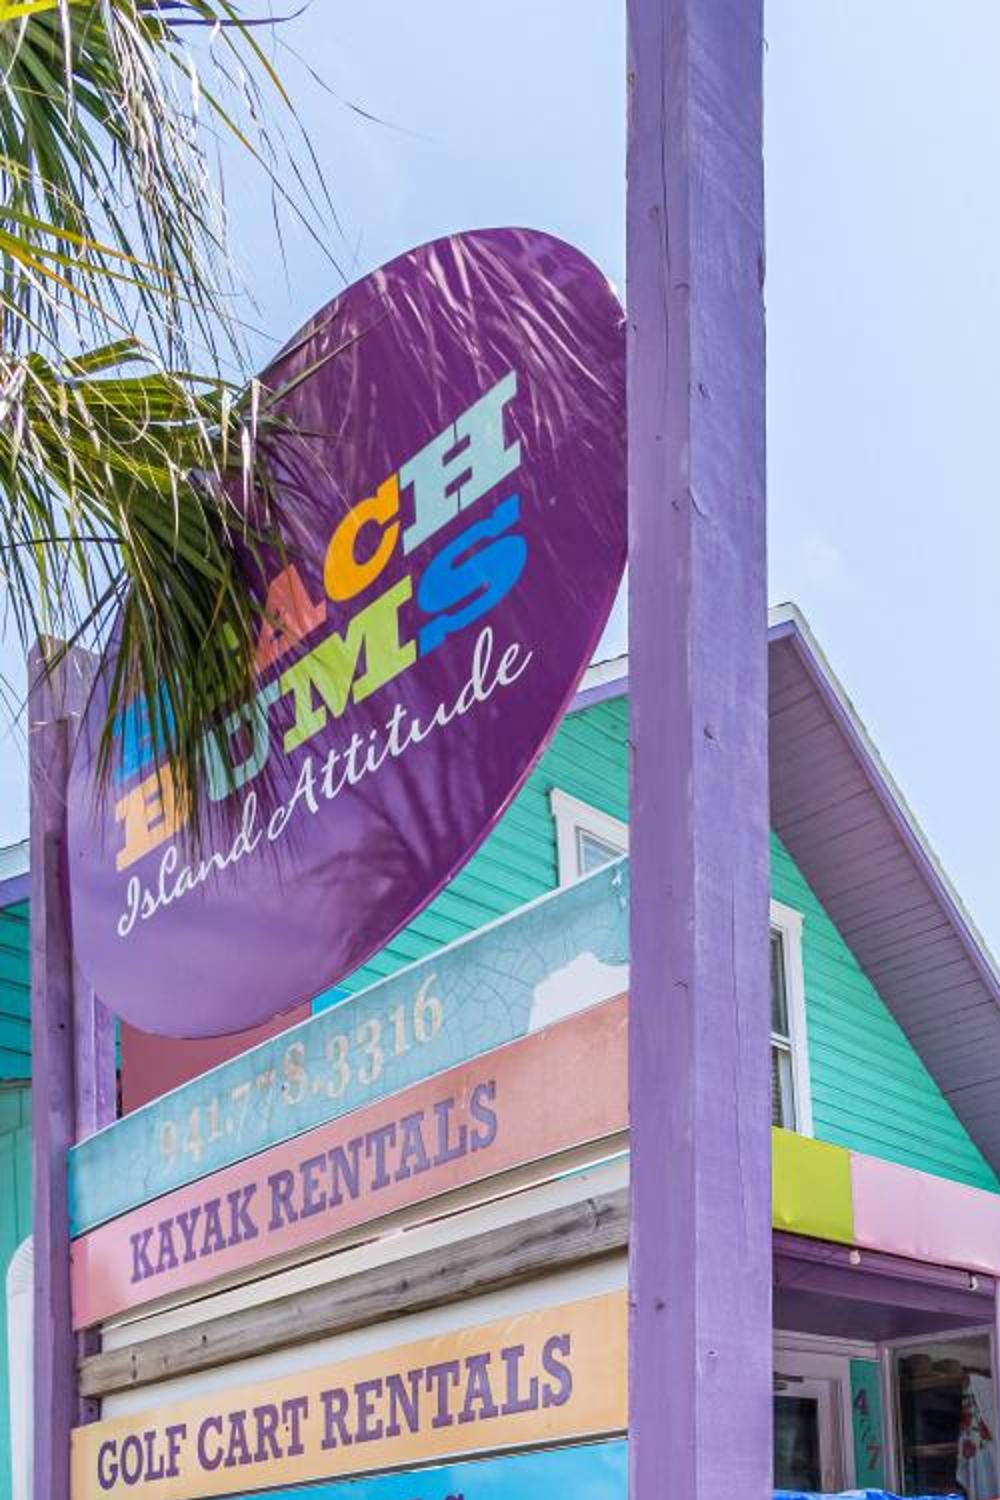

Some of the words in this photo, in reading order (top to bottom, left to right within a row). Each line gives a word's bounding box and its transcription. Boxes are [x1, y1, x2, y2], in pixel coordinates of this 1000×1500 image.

[112, 369, 521, 787] BACH
[117, 791, 264, 937] Island
[267, 625, 533, 842] Attitude
[129, 1183, 259, 1285] KAYAK
[267, 1080, 499, 1233] RENTALS
[97, 1424, 188, 1491] GOLF
[197, 1396, 309, 1471] CART
[320, 1334, 574, 1450] RENTALS
